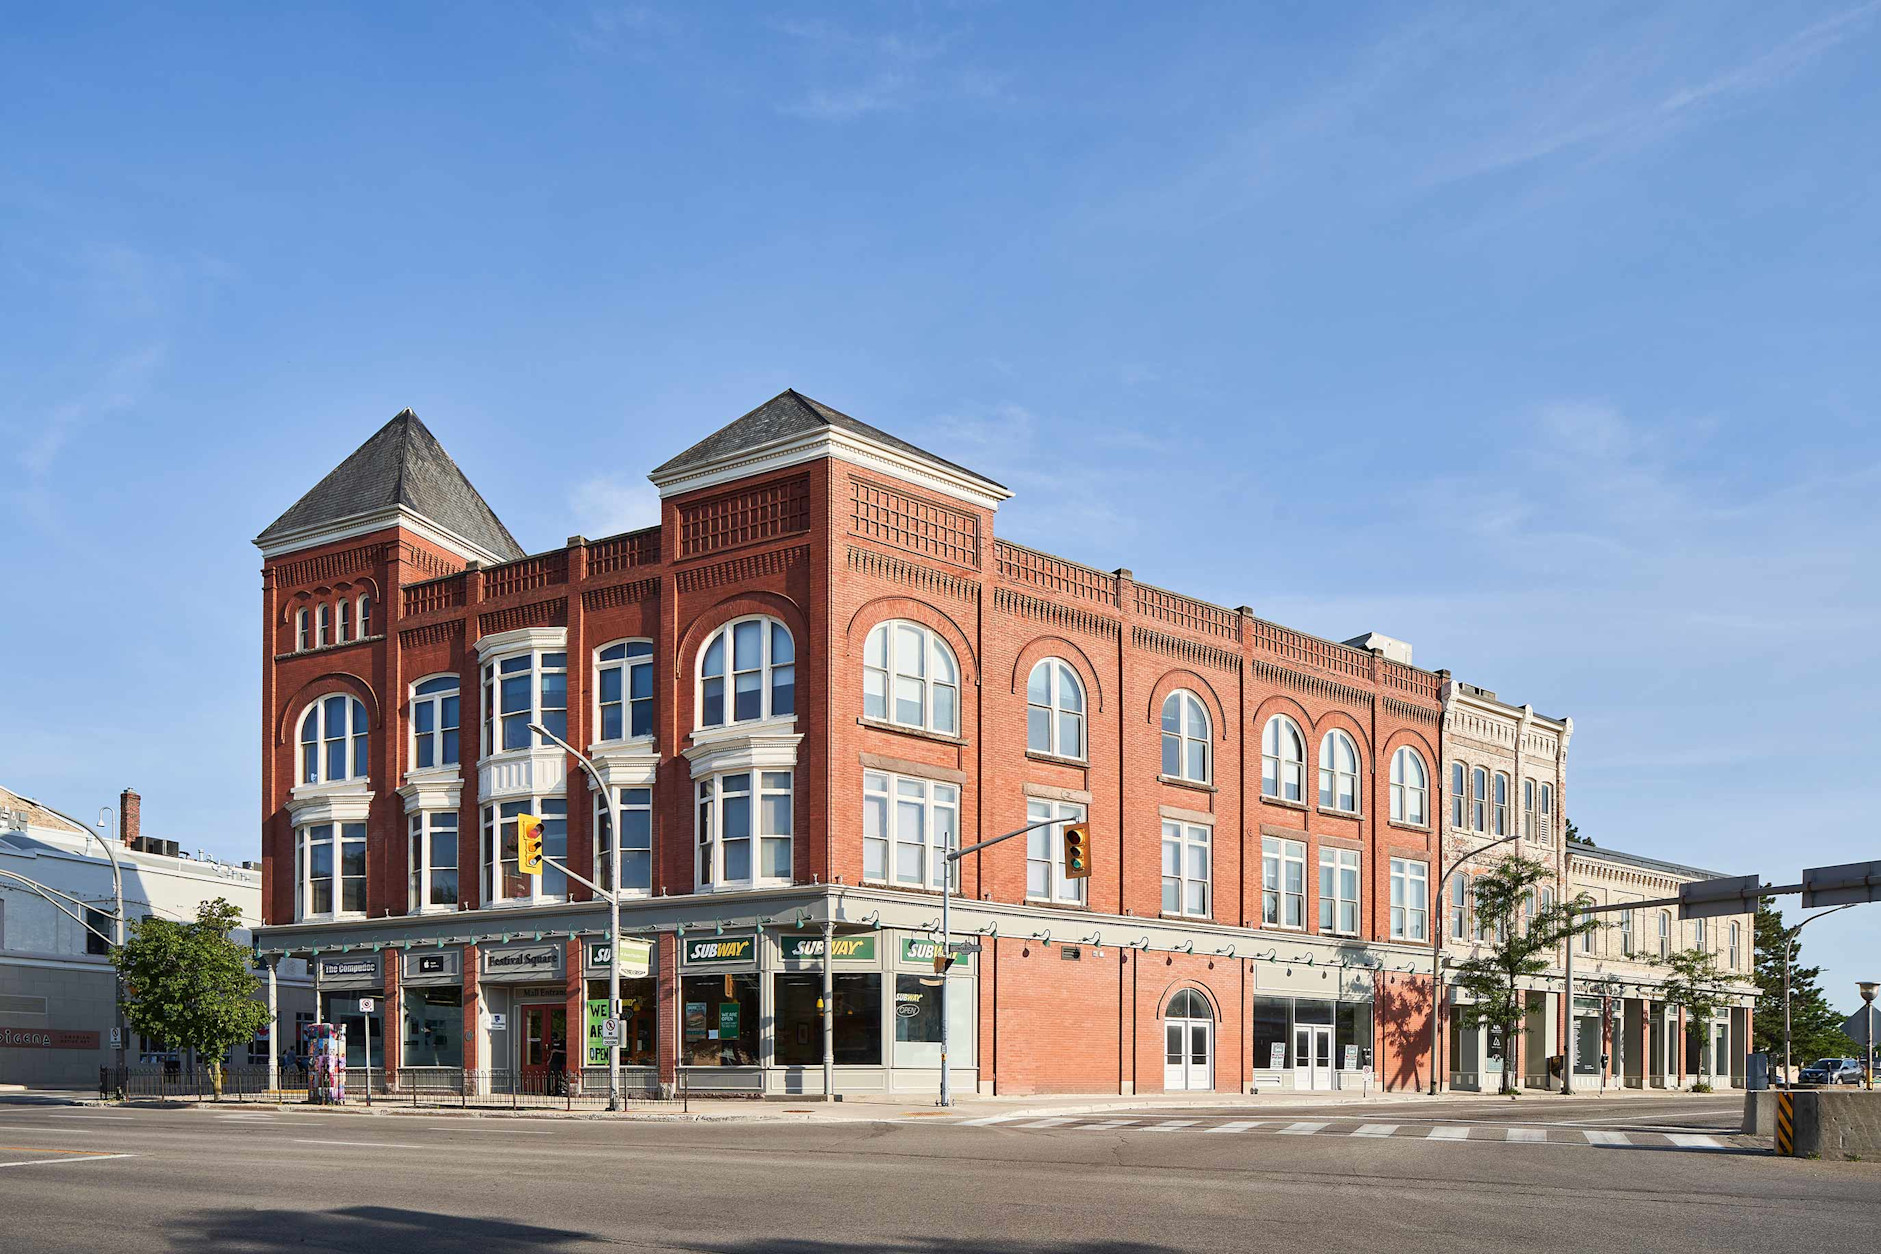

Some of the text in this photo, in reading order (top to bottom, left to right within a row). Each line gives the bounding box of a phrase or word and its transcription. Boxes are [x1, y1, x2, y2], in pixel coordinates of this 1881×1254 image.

[690, 940, 750, 960] SUBWAY
[488, 953, 557, 967] Festival Square
[325, 962, 375, 974] The Compudoc
[524, 988, 567, 997] Mall Entranc
[895, 993, 923, 1003] SUBWAY
[590, 1004, 607, 1017] WE
[899, 1006, 917, 1015] OPEN
[590, 1025, 603, 1038] AR
[590, 1047, 609, 1061] OPEN
